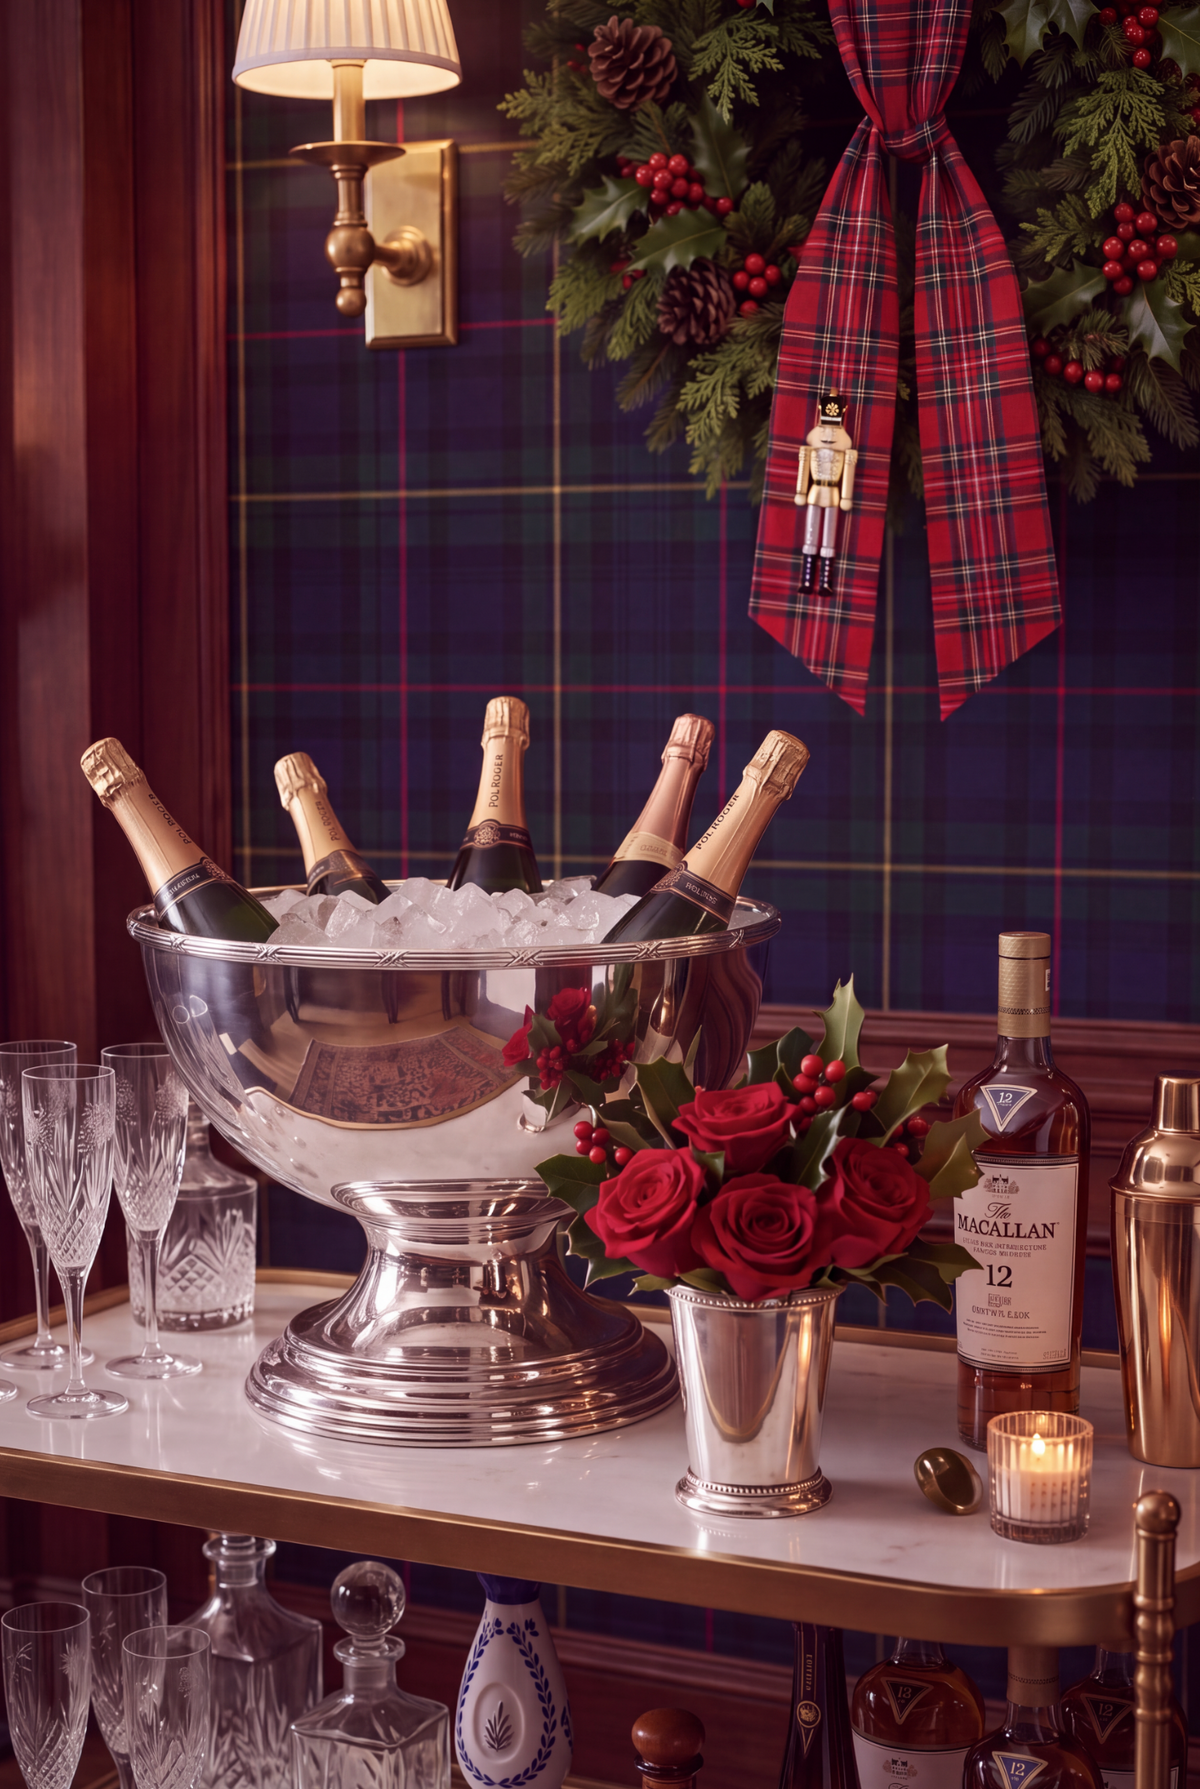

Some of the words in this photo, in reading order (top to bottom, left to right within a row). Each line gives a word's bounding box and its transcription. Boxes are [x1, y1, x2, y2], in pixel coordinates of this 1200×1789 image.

[488, 789, 500, 808] POL
[175, 828, 192, 845] POL
[695, 831, 714, 850] POL
[997, 1092, 1013, 1104] 12
[958, 1213, 1056, 1239] MACALLAN
[986, 1264, 1013, 1289] 12
[1098, 1703, 1114, 1717] 12
[1010, 1762, 1026, 1777] 12
